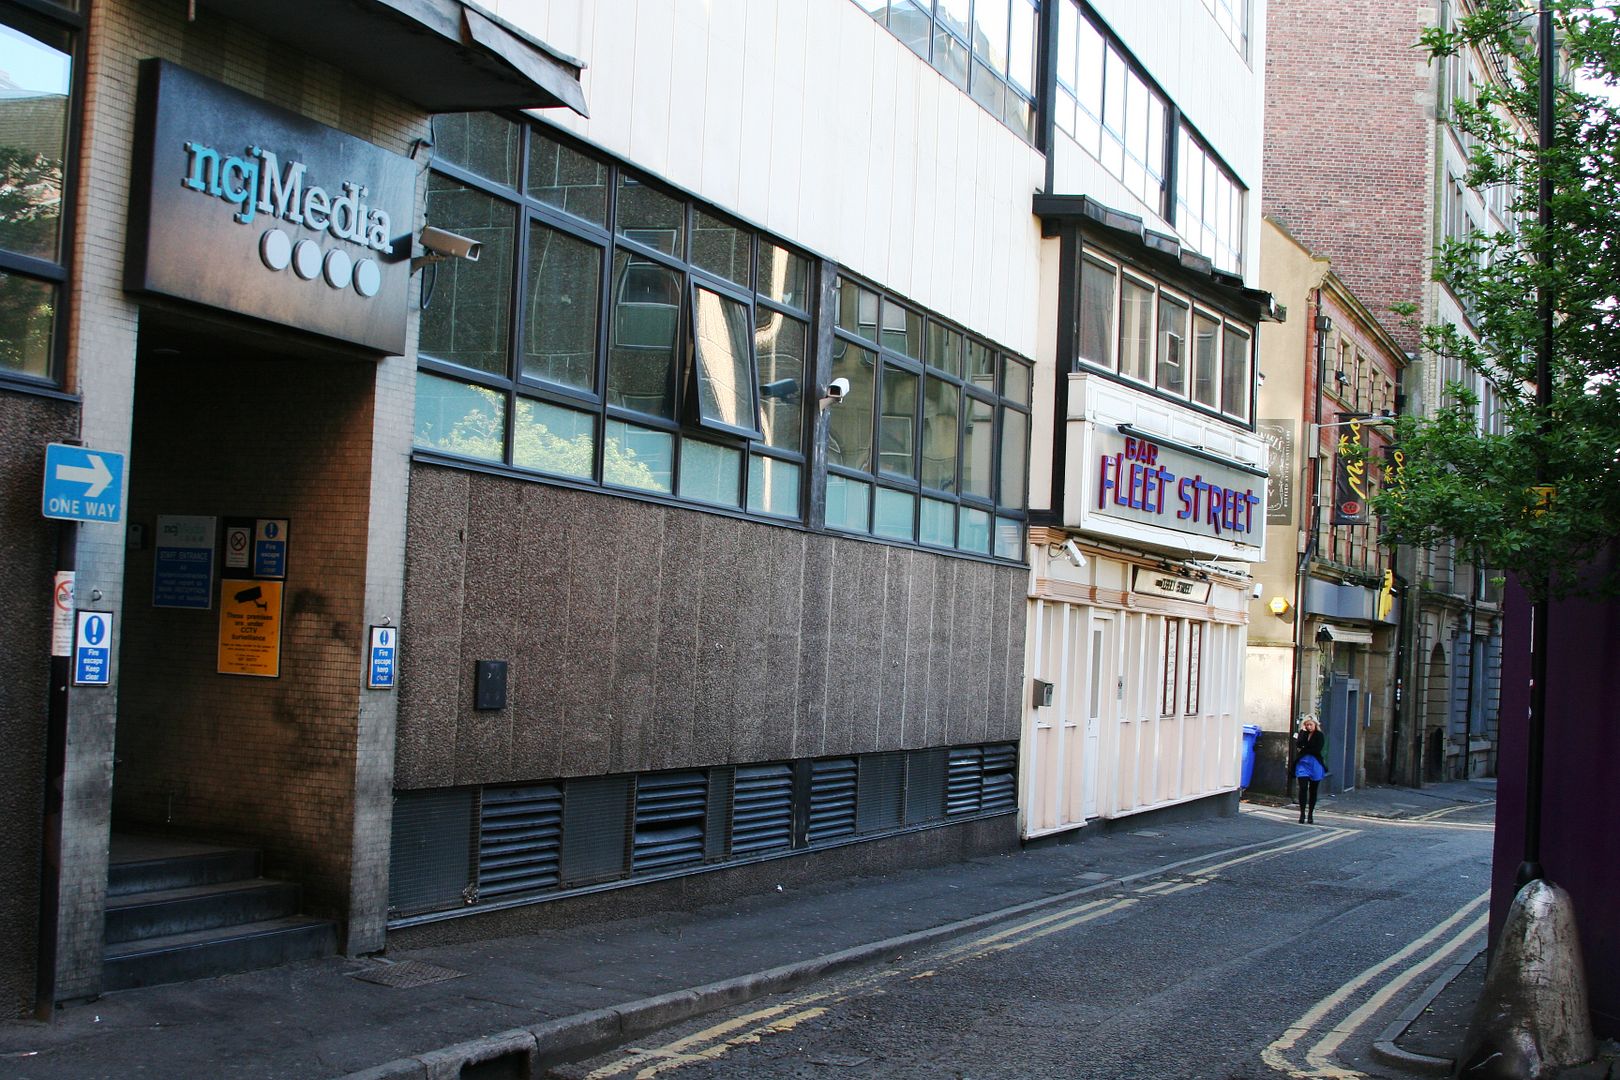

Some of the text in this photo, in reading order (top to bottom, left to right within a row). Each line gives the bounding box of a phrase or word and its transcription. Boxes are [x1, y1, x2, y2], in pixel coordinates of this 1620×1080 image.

[181, 141, 393, 254] ncjMedia
[1125, 436, 1159, 466] BAR
[1098, 453, 1260, 535] FLEET STREET
[49, 497, 116, 518] ONE WAY
[179, 551, 208, 560] ENTRANCE
[378, 649, 389, 657] Fire
[85, 673, 100, 681] clear
